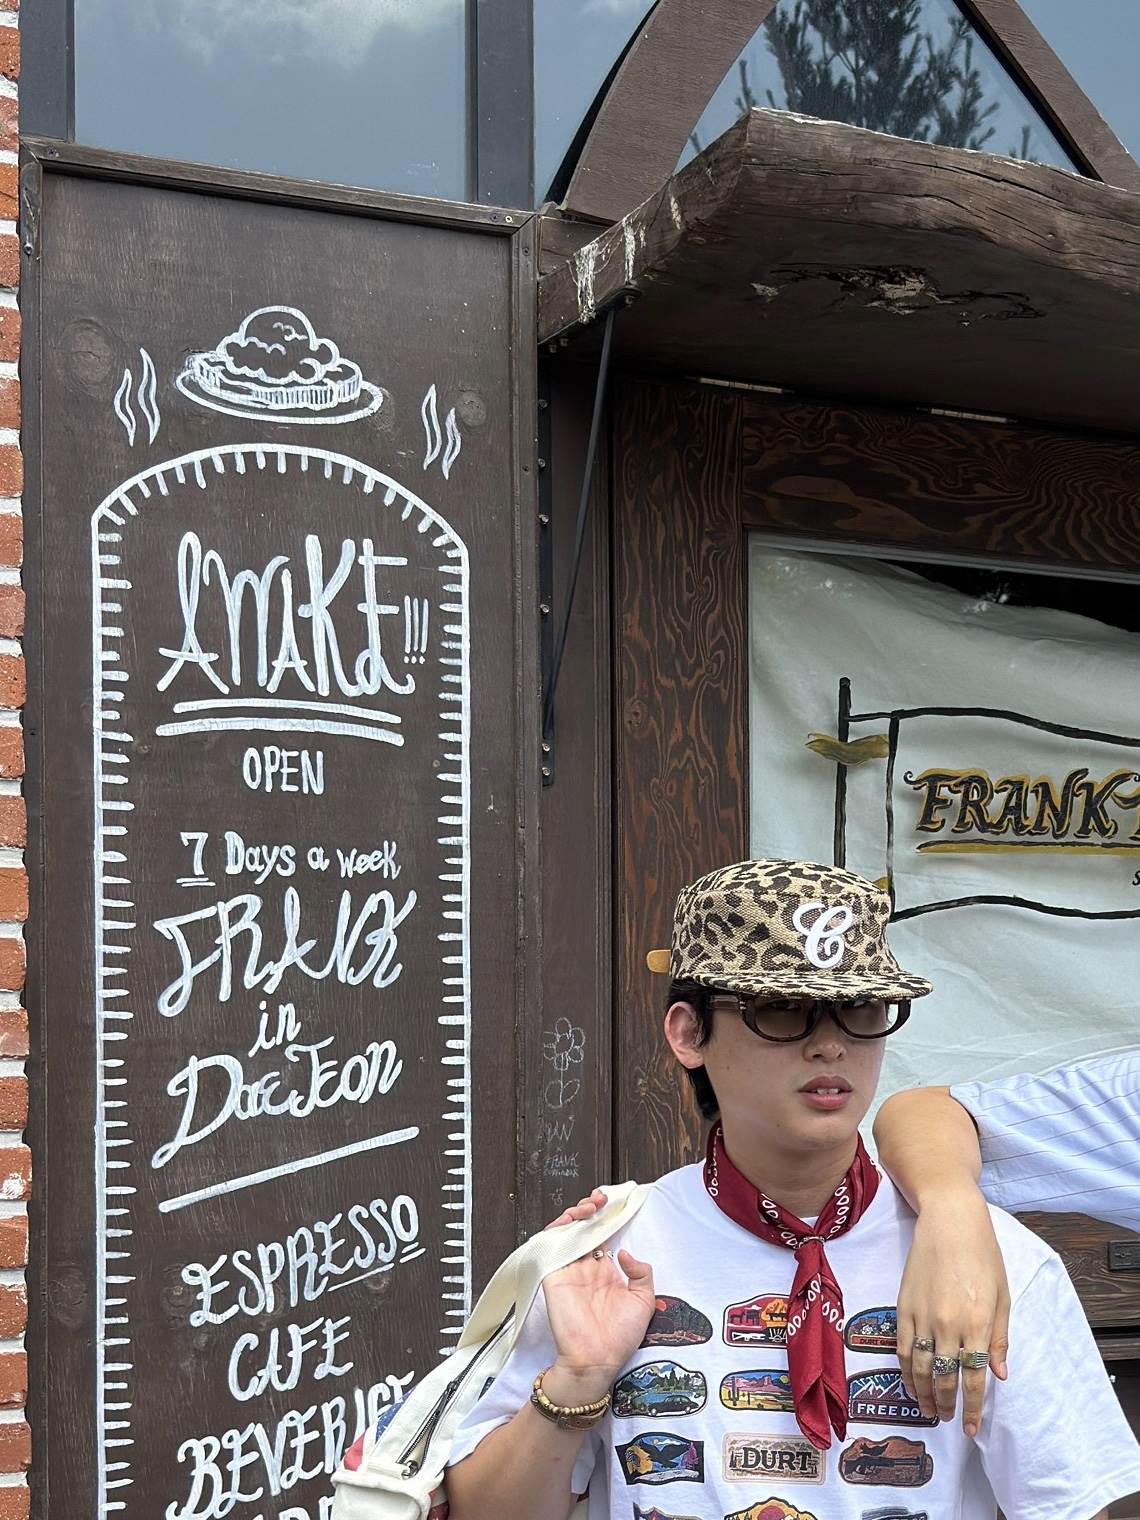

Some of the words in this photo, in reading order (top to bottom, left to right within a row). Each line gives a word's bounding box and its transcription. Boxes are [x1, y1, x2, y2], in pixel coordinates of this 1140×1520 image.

[242, 746, 325, 795] OPEN
[181, 831, 209, 876] 7
[224, 830, 297, 885] Days
[307, 846, 331, 872] a
[248, 1000, 302, 1058] in
[181, 1194, 419, 1327] ESPRESSO
[227, 1315, 355, 1402] CAFE
[857, 1402, 923, 1417] FREEDO
[741, 1445, 812, 1472] DURT
